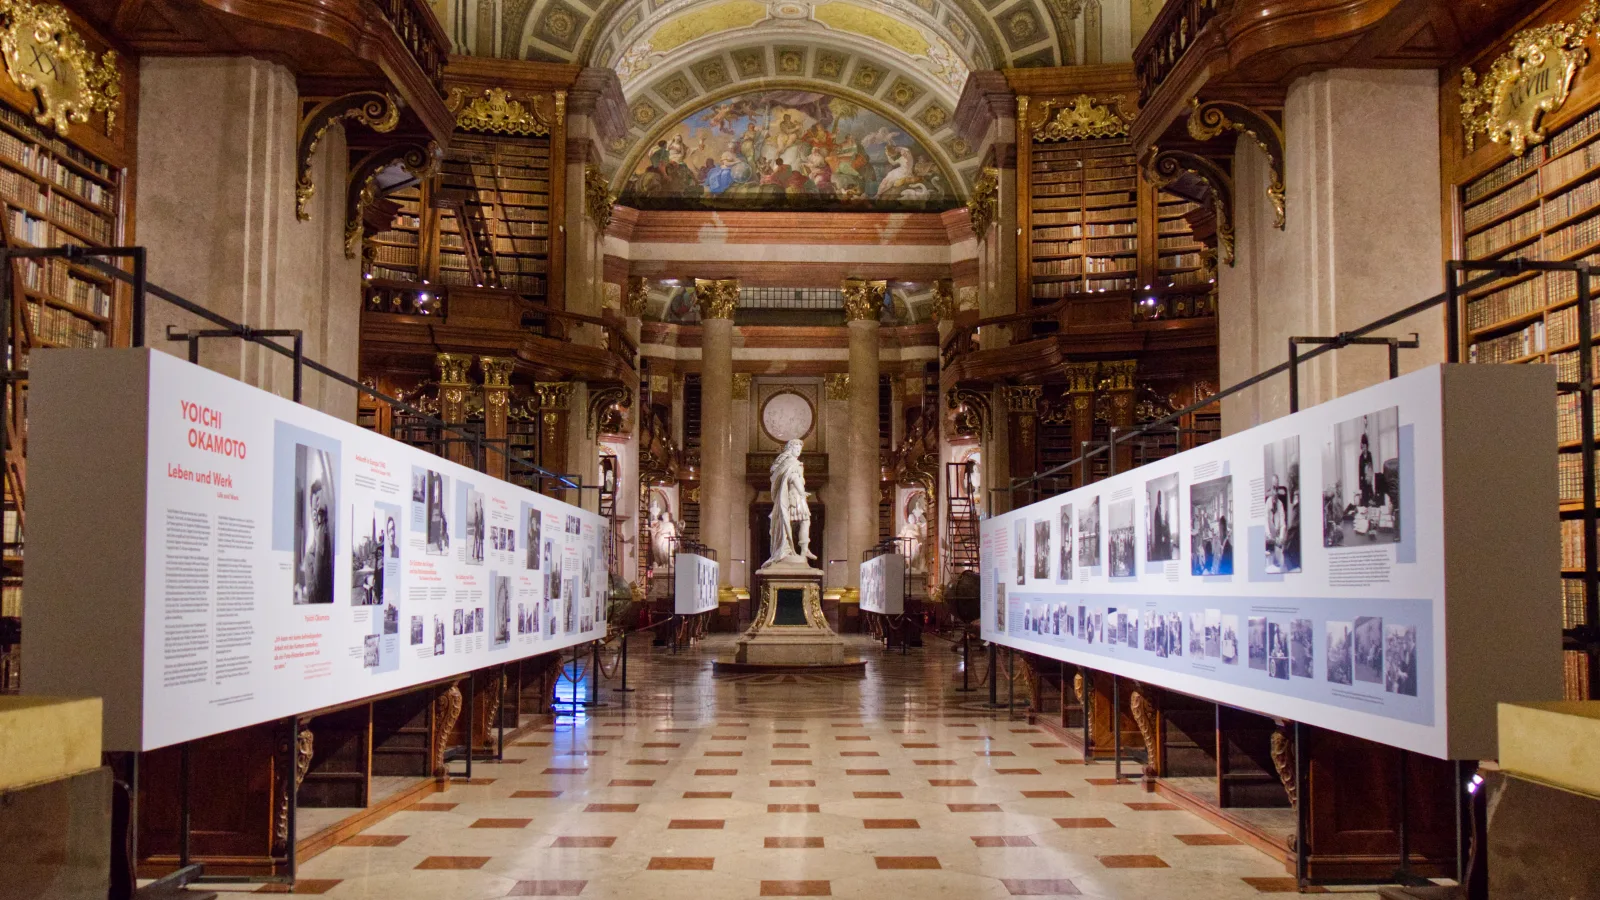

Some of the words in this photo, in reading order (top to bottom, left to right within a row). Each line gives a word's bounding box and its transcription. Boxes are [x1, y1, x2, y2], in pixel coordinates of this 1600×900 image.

[181, 399, 222, 430] YOICHI
[188, 428, 247, 460] OKAMOTO
[168, 462, 194, 482] Leben
[196, 470, 212, 485] und
[213, 471, 233, 489] Werk
